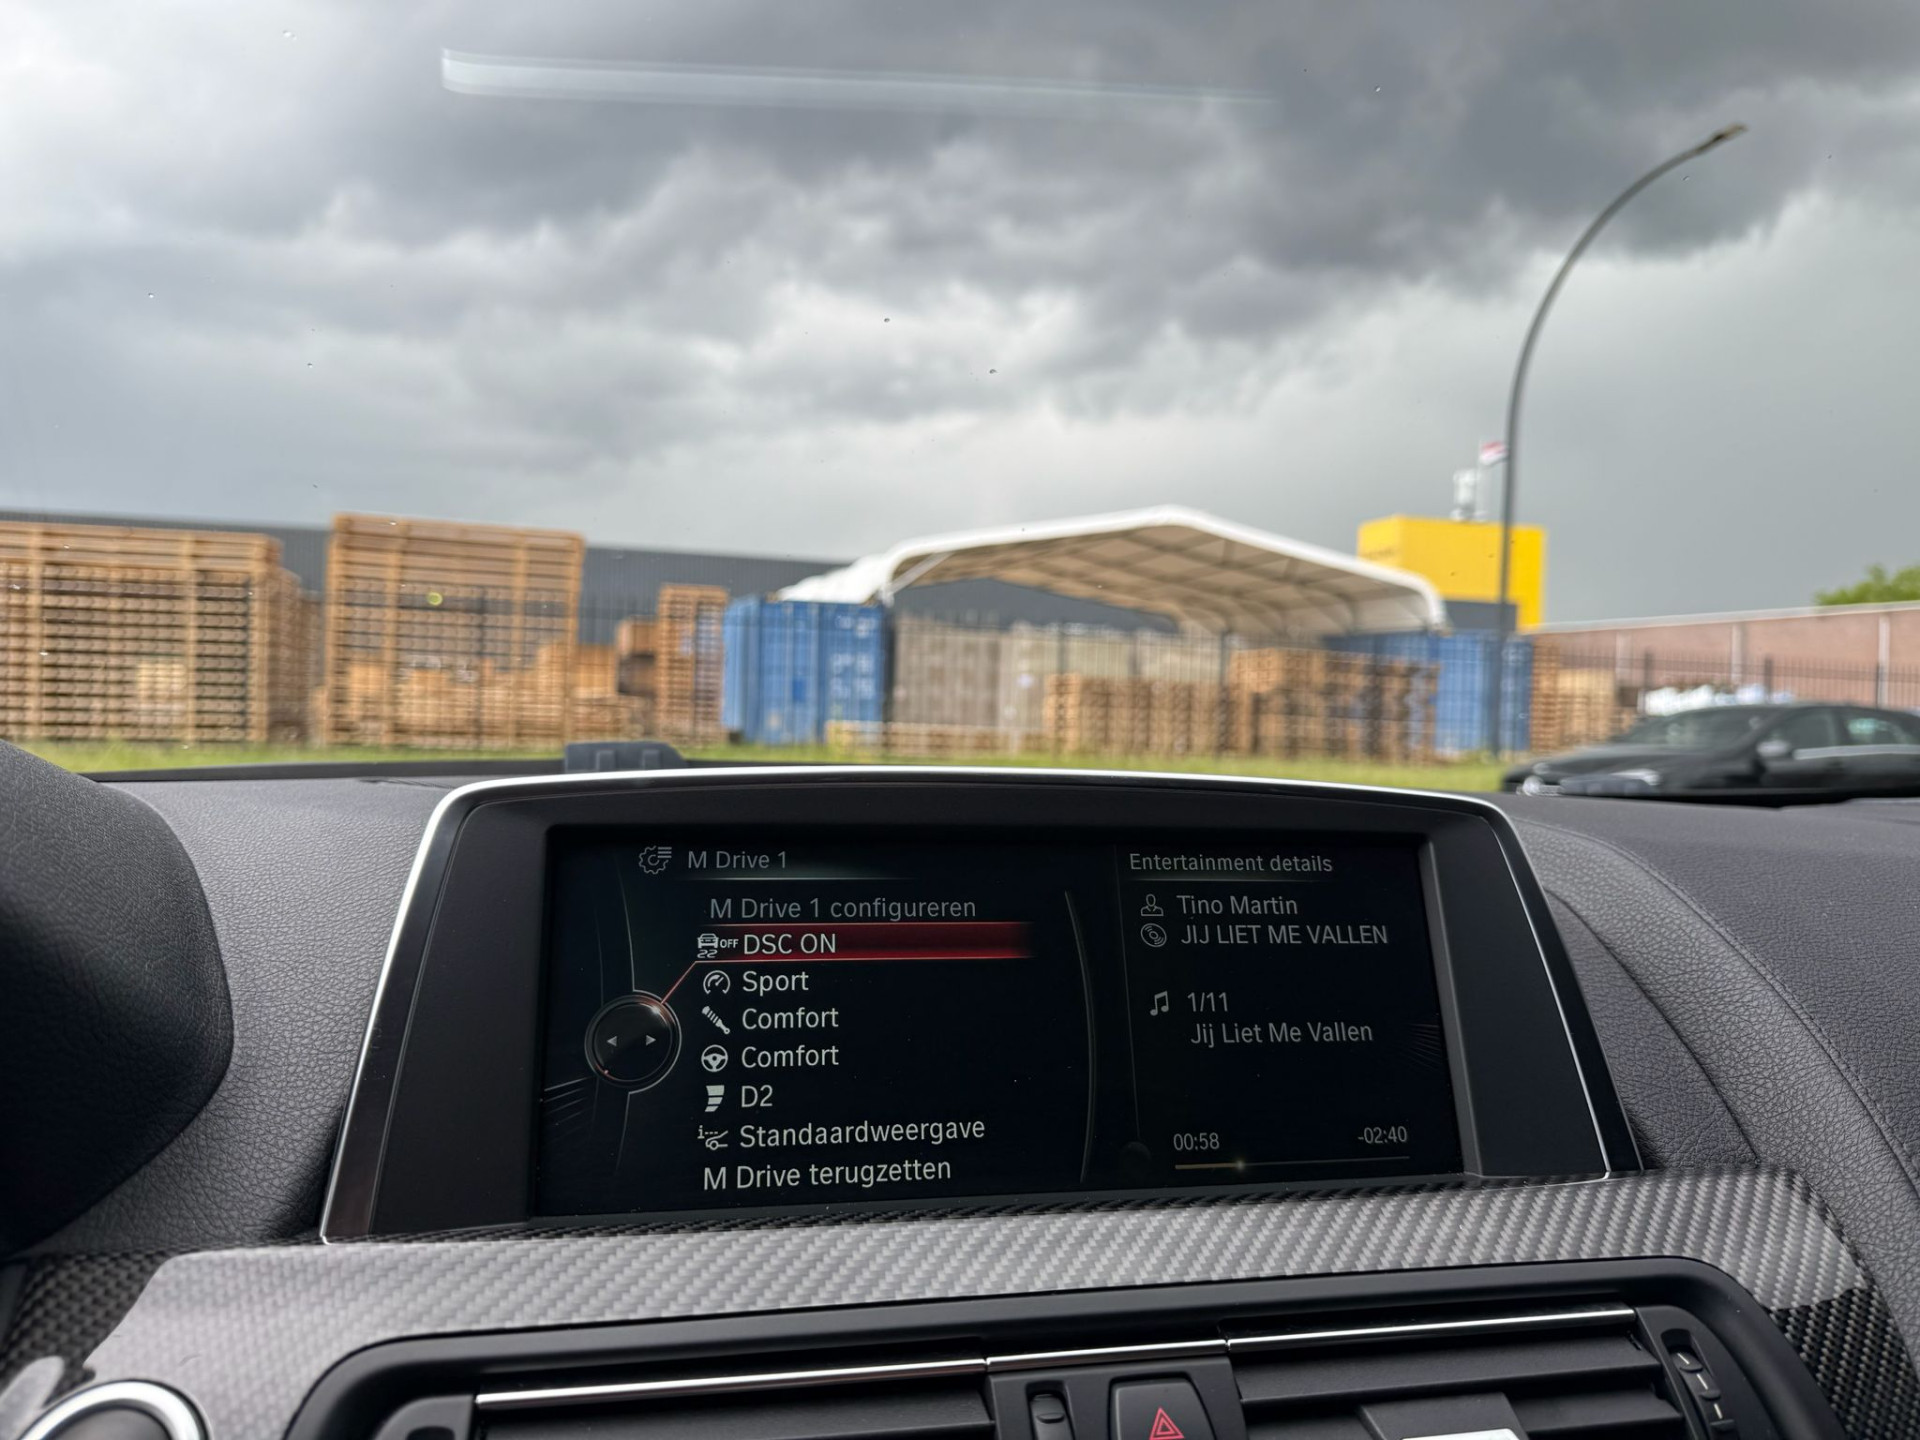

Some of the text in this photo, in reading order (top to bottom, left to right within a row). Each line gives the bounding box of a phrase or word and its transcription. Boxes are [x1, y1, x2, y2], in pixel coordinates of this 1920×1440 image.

[688, 850, 786, 870] M Drive 1
[1130, 853, 1333, 872] Entertainment details
[710, 898, 976, 921] M Drive 1 configureren
[1177, 895, 1298, 915] Tino Martin
[720, 939, 738, 948] OFF
[743, 933, 837, 955] DSC ON
[1181, 925, 1388, 945] JIJ LIET ME VALLEN
[742, 971, 809, 996] Sport
[1187, 992, 1229, 1012] 1/11
[742, 1007, 839, 1030] Comfort
[1191, 1022, 1373, 1048] Jij Liet Me Vallen
[741, 1045, 839, 1068] Comfort
[741, 1086, 773, 1108] D2
[740, 1119, 985, 1148] Standaardweergave
[1173, 1133, 1220, 1151] 00:58
[1357, 1126, 1407, 1144] -02:40
[703, 1159, 951, 1190] M Drive terugzetten
